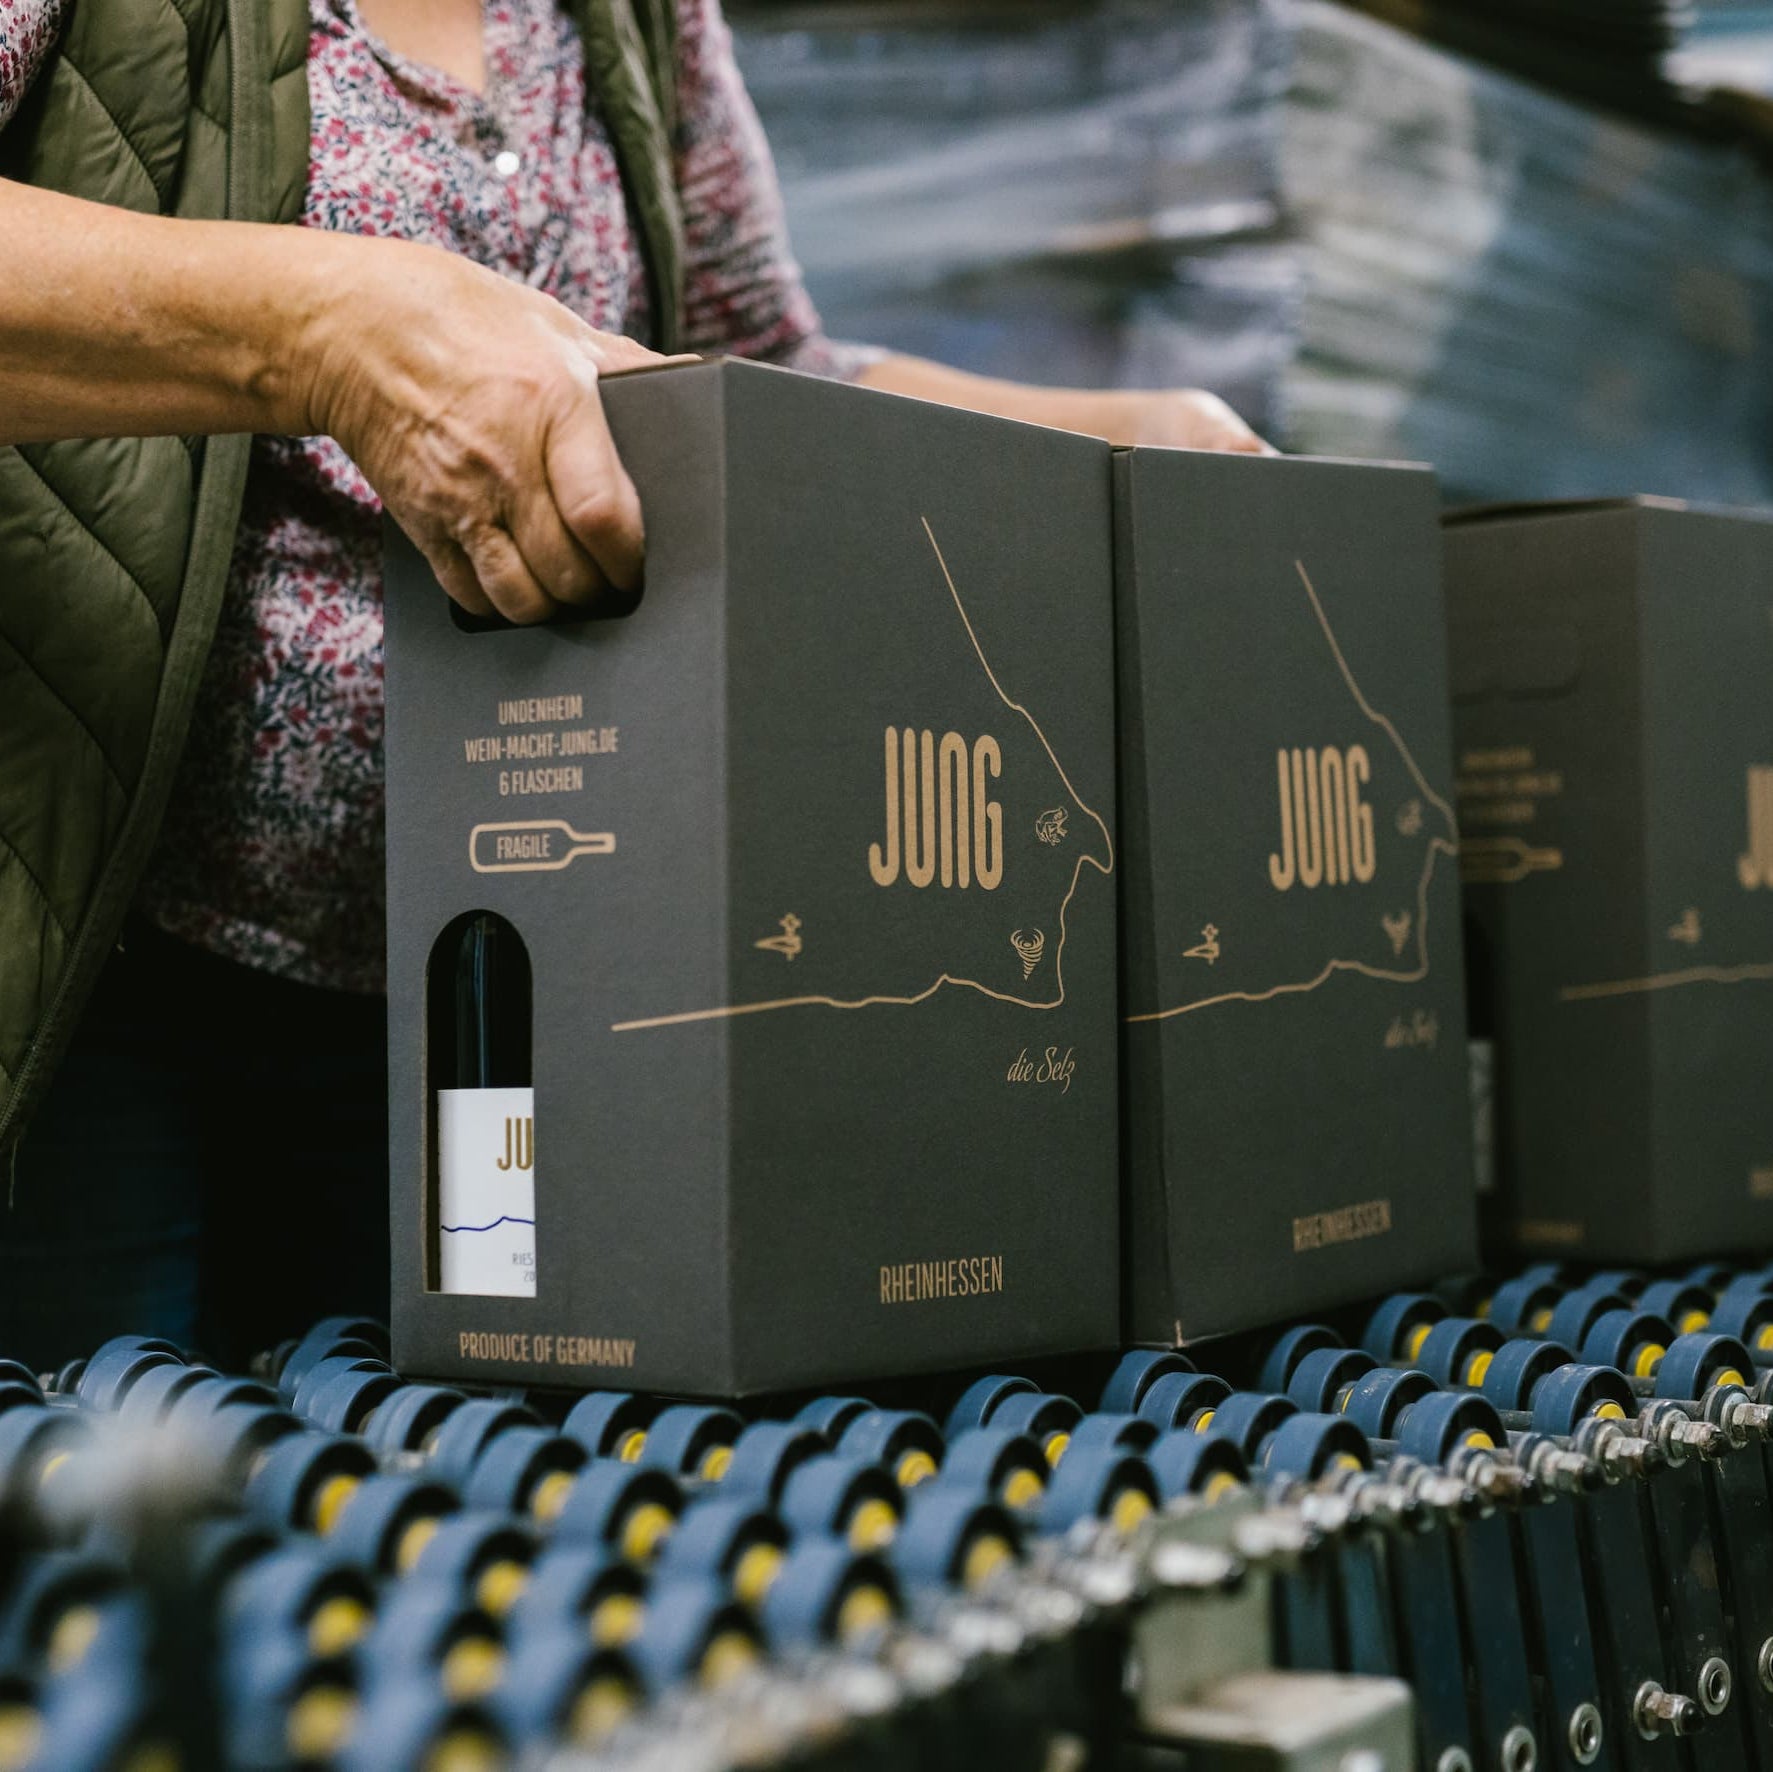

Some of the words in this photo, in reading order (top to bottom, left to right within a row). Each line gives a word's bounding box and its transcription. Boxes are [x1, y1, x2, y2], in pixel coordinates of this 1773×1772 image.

[498, 694, 583, 725] UNDENHEIM
[464, 726, 619, 762] WEIN-MACHT-JUNG.DE
[499, 770, 508, 796] 6
[511, 766, 583, 795] FLASCHEN
[868, 725, 1004, 891] JUNG
[1268, 744, 1376, 891] JUNG
[496, 833, 551, 860] FRAGILE
[1006, 1048, 1034, 1082] die
[1036, 1046, 1075, 1096] Selz
[879, 1255, 1004, 1305] RHEINHESSEN
[458, 1331, 531, 1362] PRODUCE
[533, 1334, 553, 1364] OF
[556, 1335, 637, 1368] GERMANY
